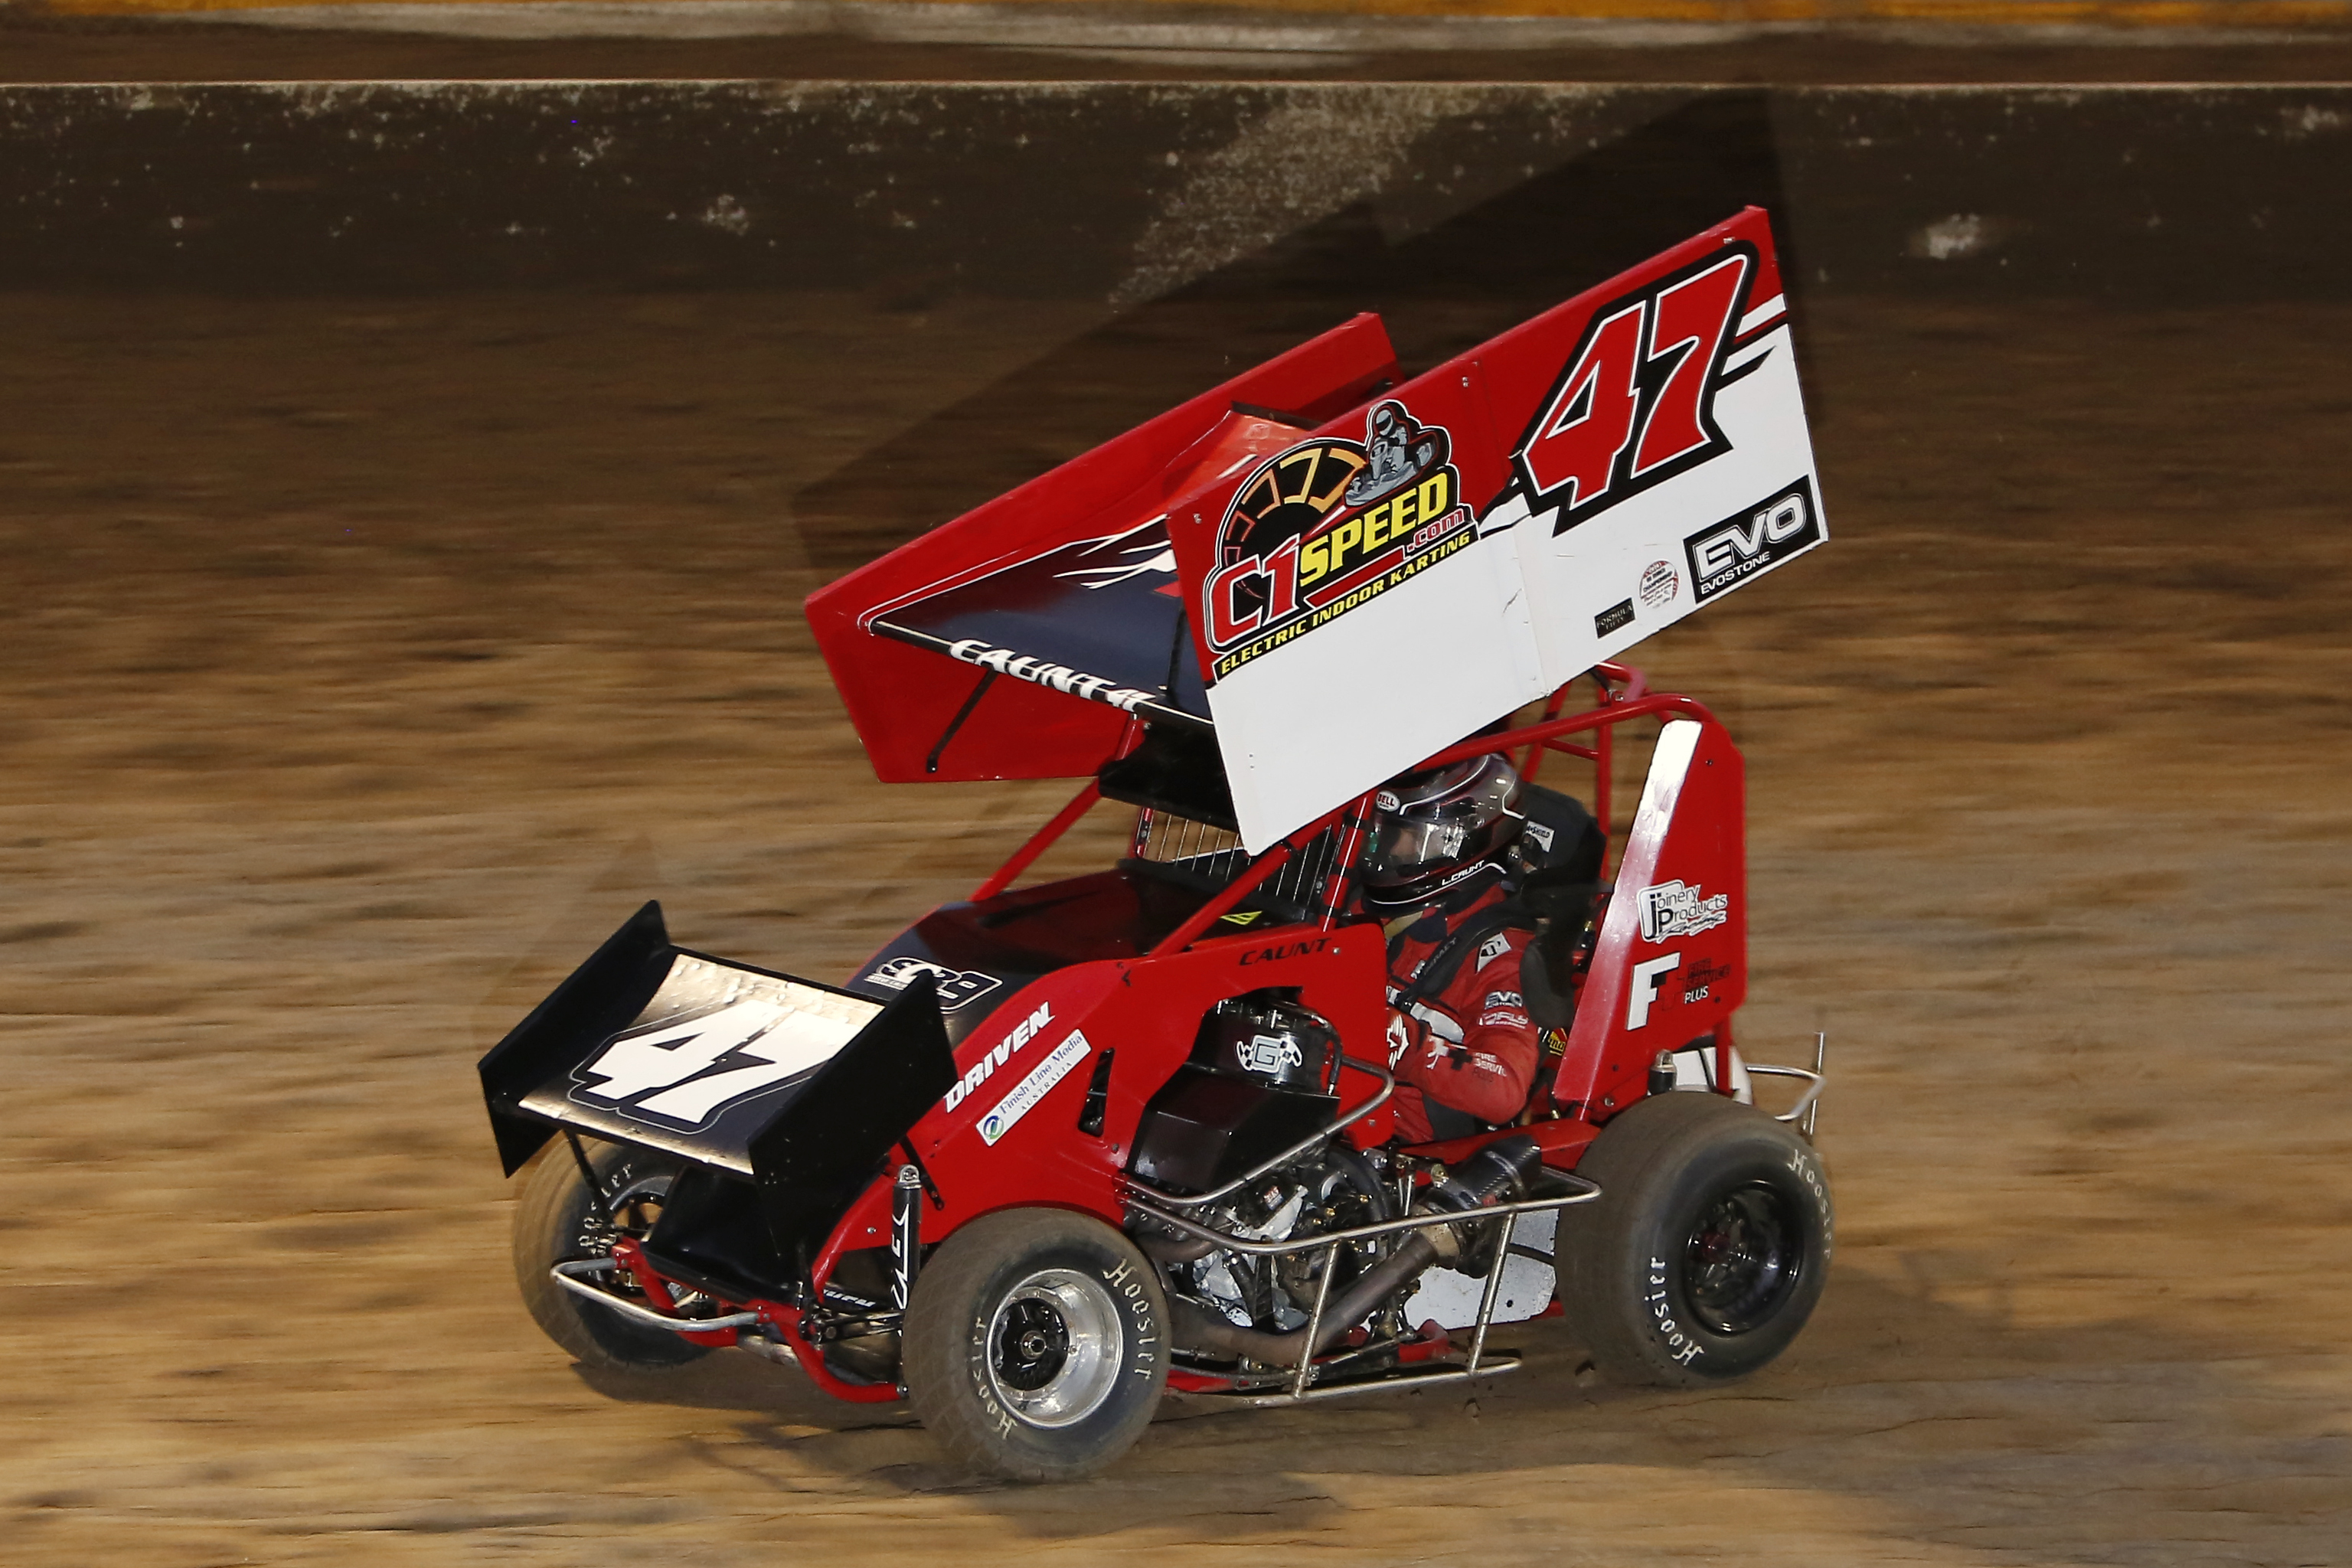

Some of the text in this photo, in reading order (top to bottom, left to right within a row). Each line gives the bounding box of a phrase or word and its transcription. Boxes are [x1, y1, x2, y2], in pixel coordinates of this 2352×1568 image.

[1521, 253, 1749, 511] 47
[1209, 534, 1300, 648] C1
[1299, 472, 1449, 587] SPEED
[1693, 493, 1808, 583] EVO
[1700, 551, 1771, 595] EVOSTONE
[1221, 531, 1472, 675] ELECTRIC INDOOR KARTING
[949, 638, 1117, 700] CAUNT
[1377, 793, 1395, 807] BELL
[1239, 936, 1332, 966] CAUNT
[1684, 985, 1709, 1004] PLUS
[586, 999, 864, 1124] 47
[943, 1001, 1056, 1113] DRIVEN
[999, 1034, 1084, 1115] Finish Line Media
[1021, 1061, 1073, 1112] AUSTRALIA
